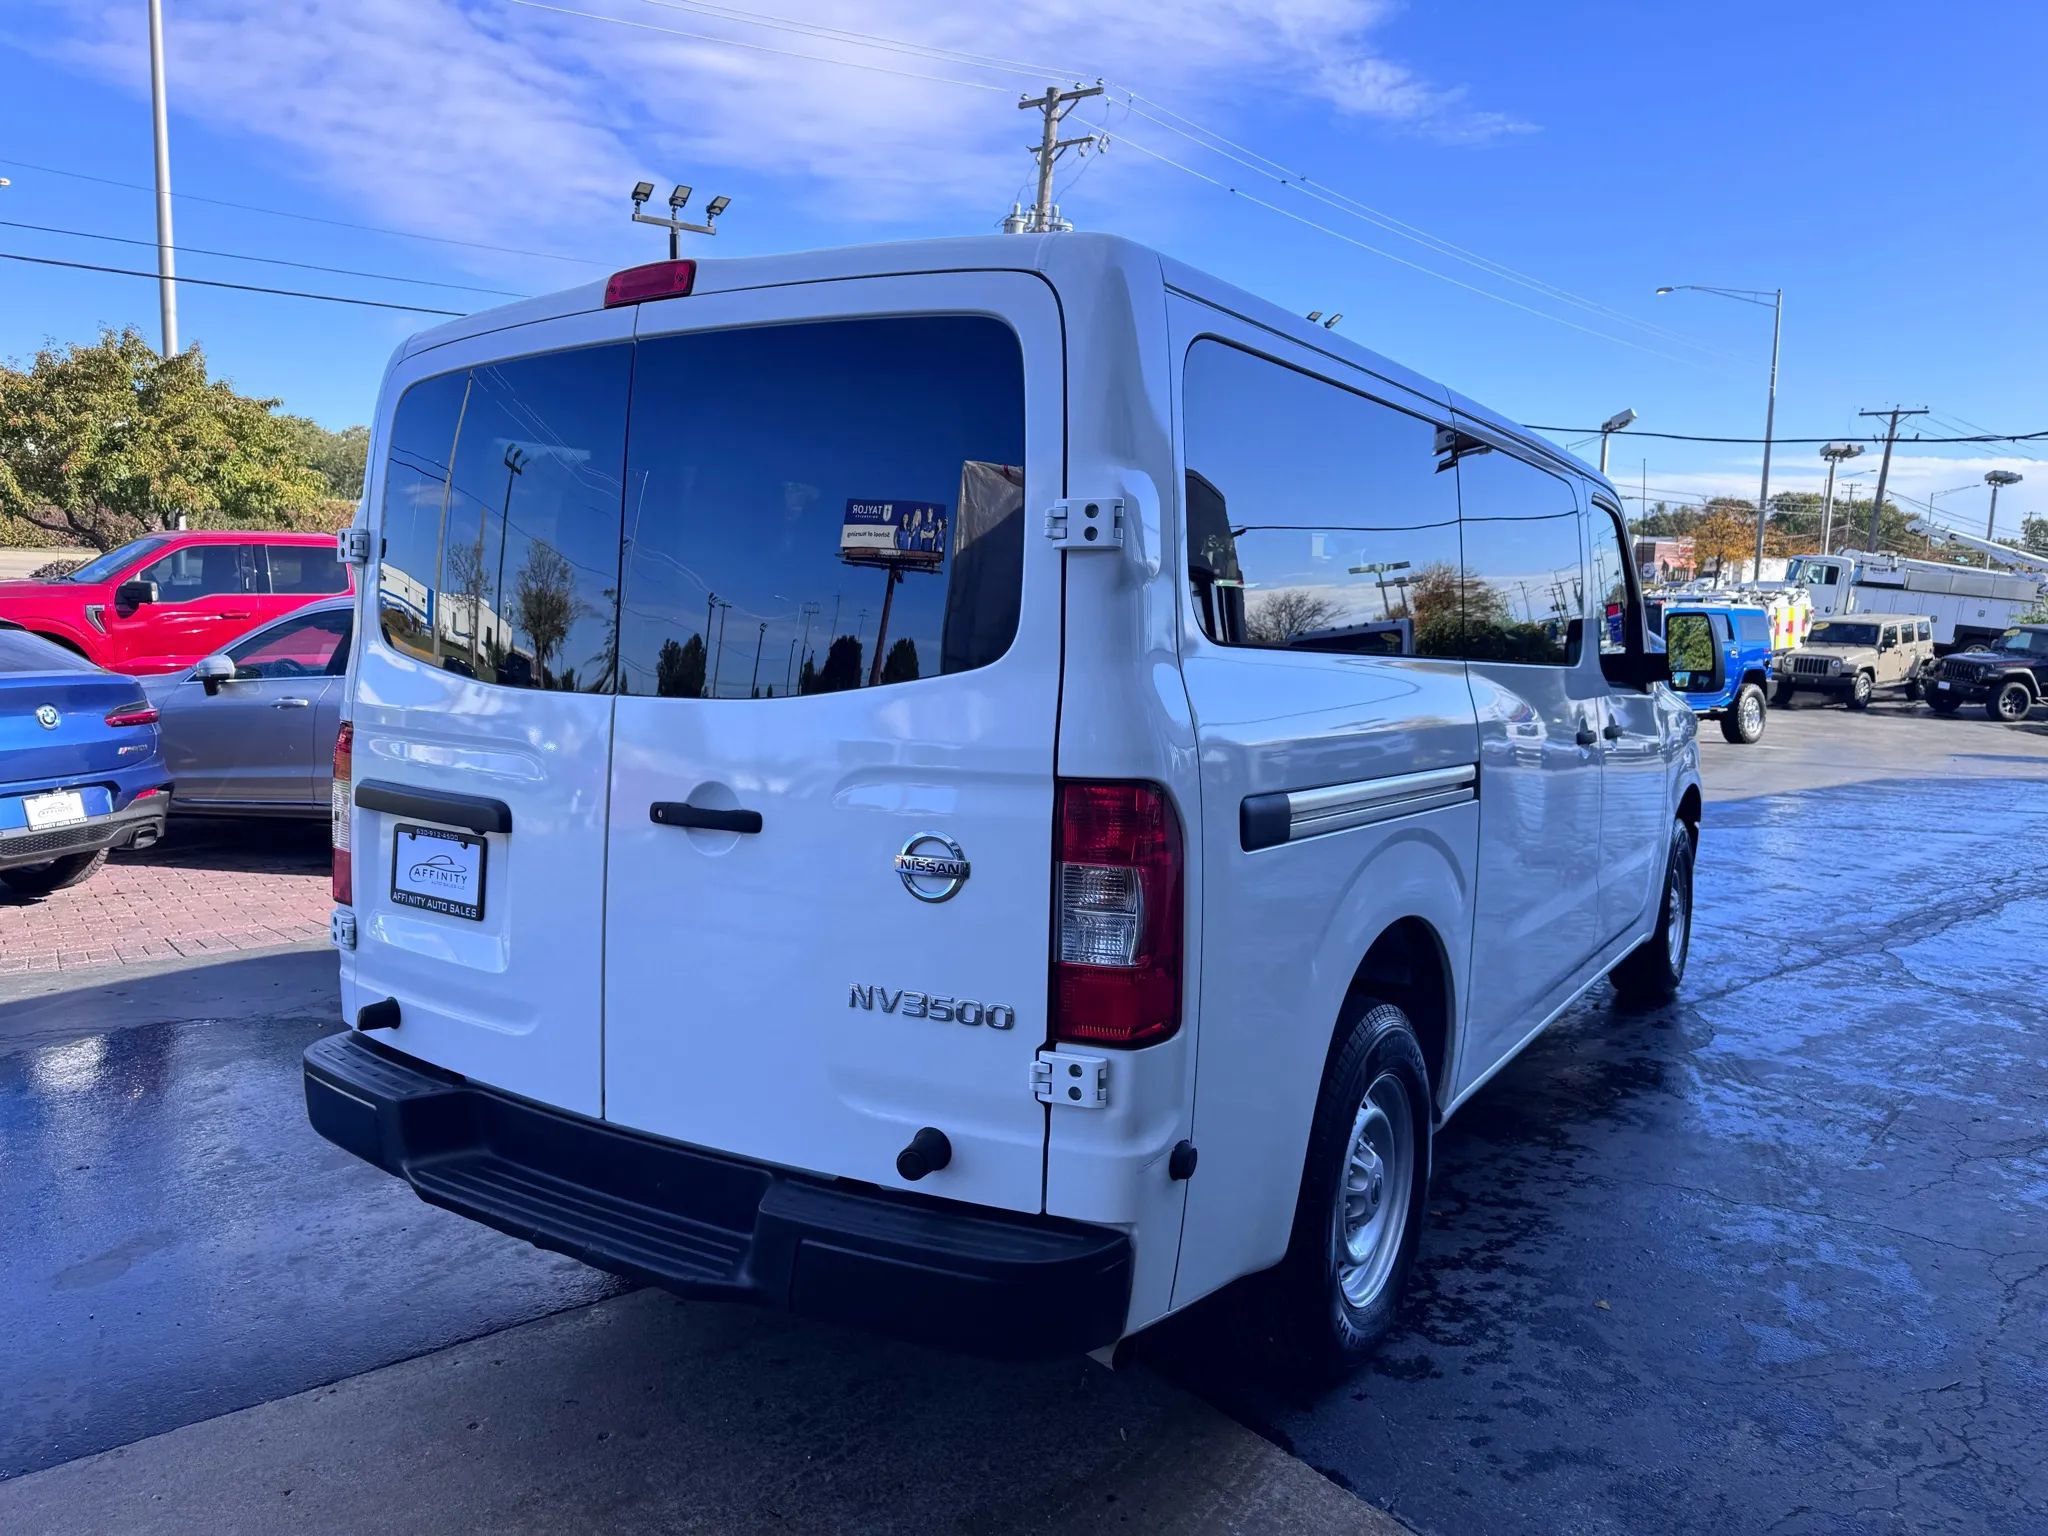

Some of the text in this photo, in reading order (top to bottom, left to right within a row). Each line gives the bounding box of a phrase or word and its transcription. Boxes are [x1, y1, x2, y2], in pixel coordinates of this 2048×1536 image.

[414, 868, 467, 884] AFFINITY
[900, 858, 960, 875] NISSAN
[392, 892, 477, 917] AFFINITY AUTO SALES
[849, 983, 1015, 1031] NV3500
